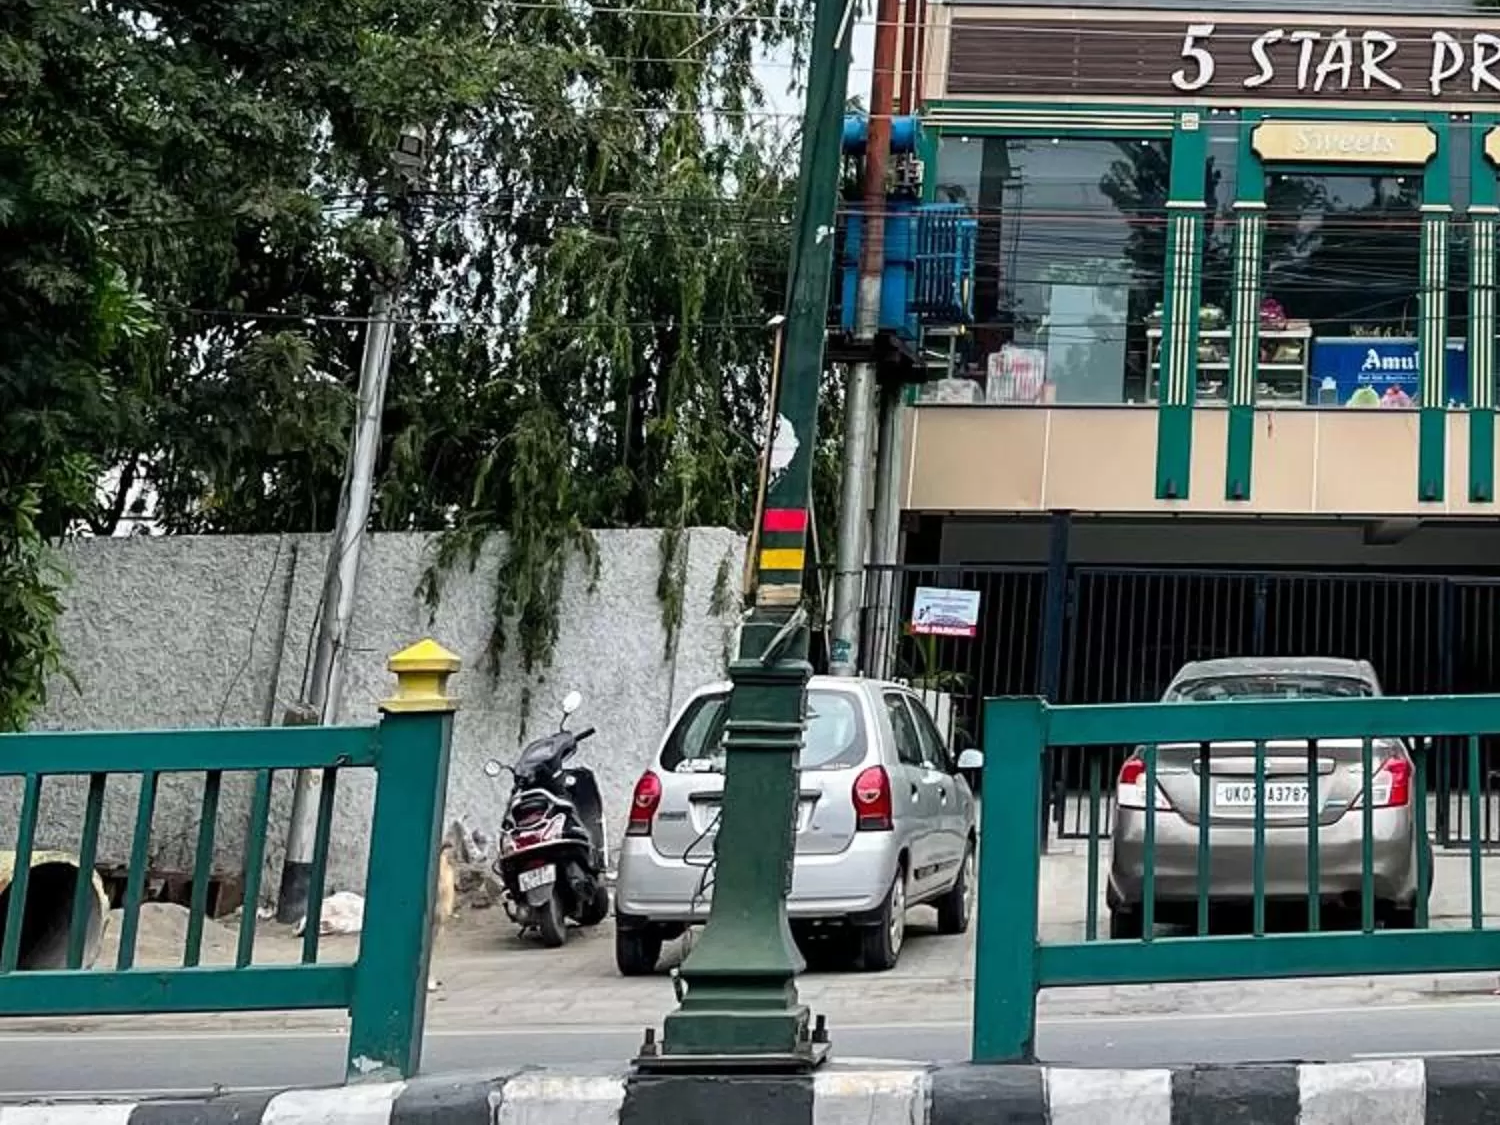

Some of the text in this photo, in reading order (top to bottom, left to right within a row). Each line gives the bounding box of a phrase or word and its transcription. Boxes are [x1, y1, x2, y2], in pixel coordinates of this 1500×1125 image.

[1171, 23, 1215, 92] 5
[1243, 28, 1403, 94] STAR
[1294, 126, 1394, 155] Sweets
[1361, 348, 1420, 372] Amul
